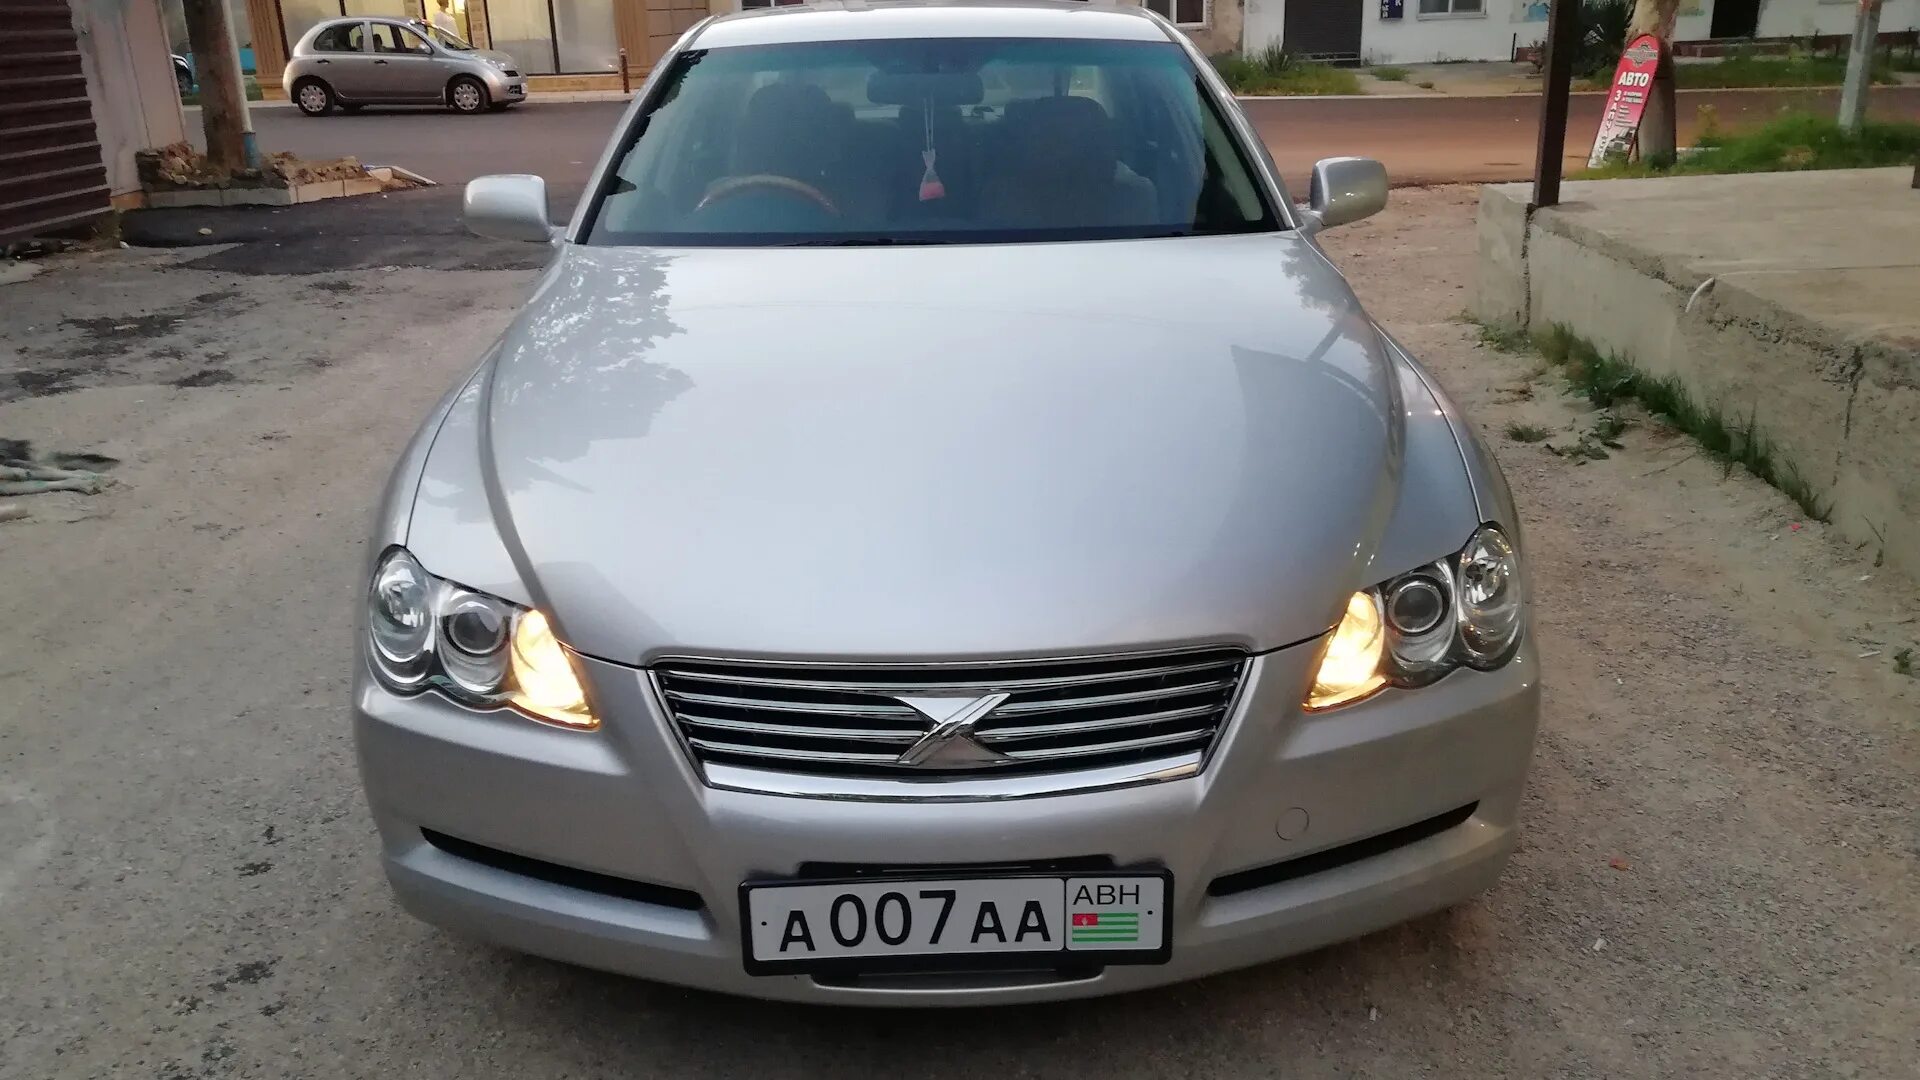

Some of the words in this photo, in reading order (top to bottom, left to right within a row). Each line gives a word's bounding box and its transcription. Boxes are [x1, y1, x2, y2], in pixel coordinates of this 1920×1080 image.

[1618, 71, 1649, 87] АВТО
[1595, 89, 1622, 160] ЗАПЧАС
[1072, 884, 1141, 906] ABH
